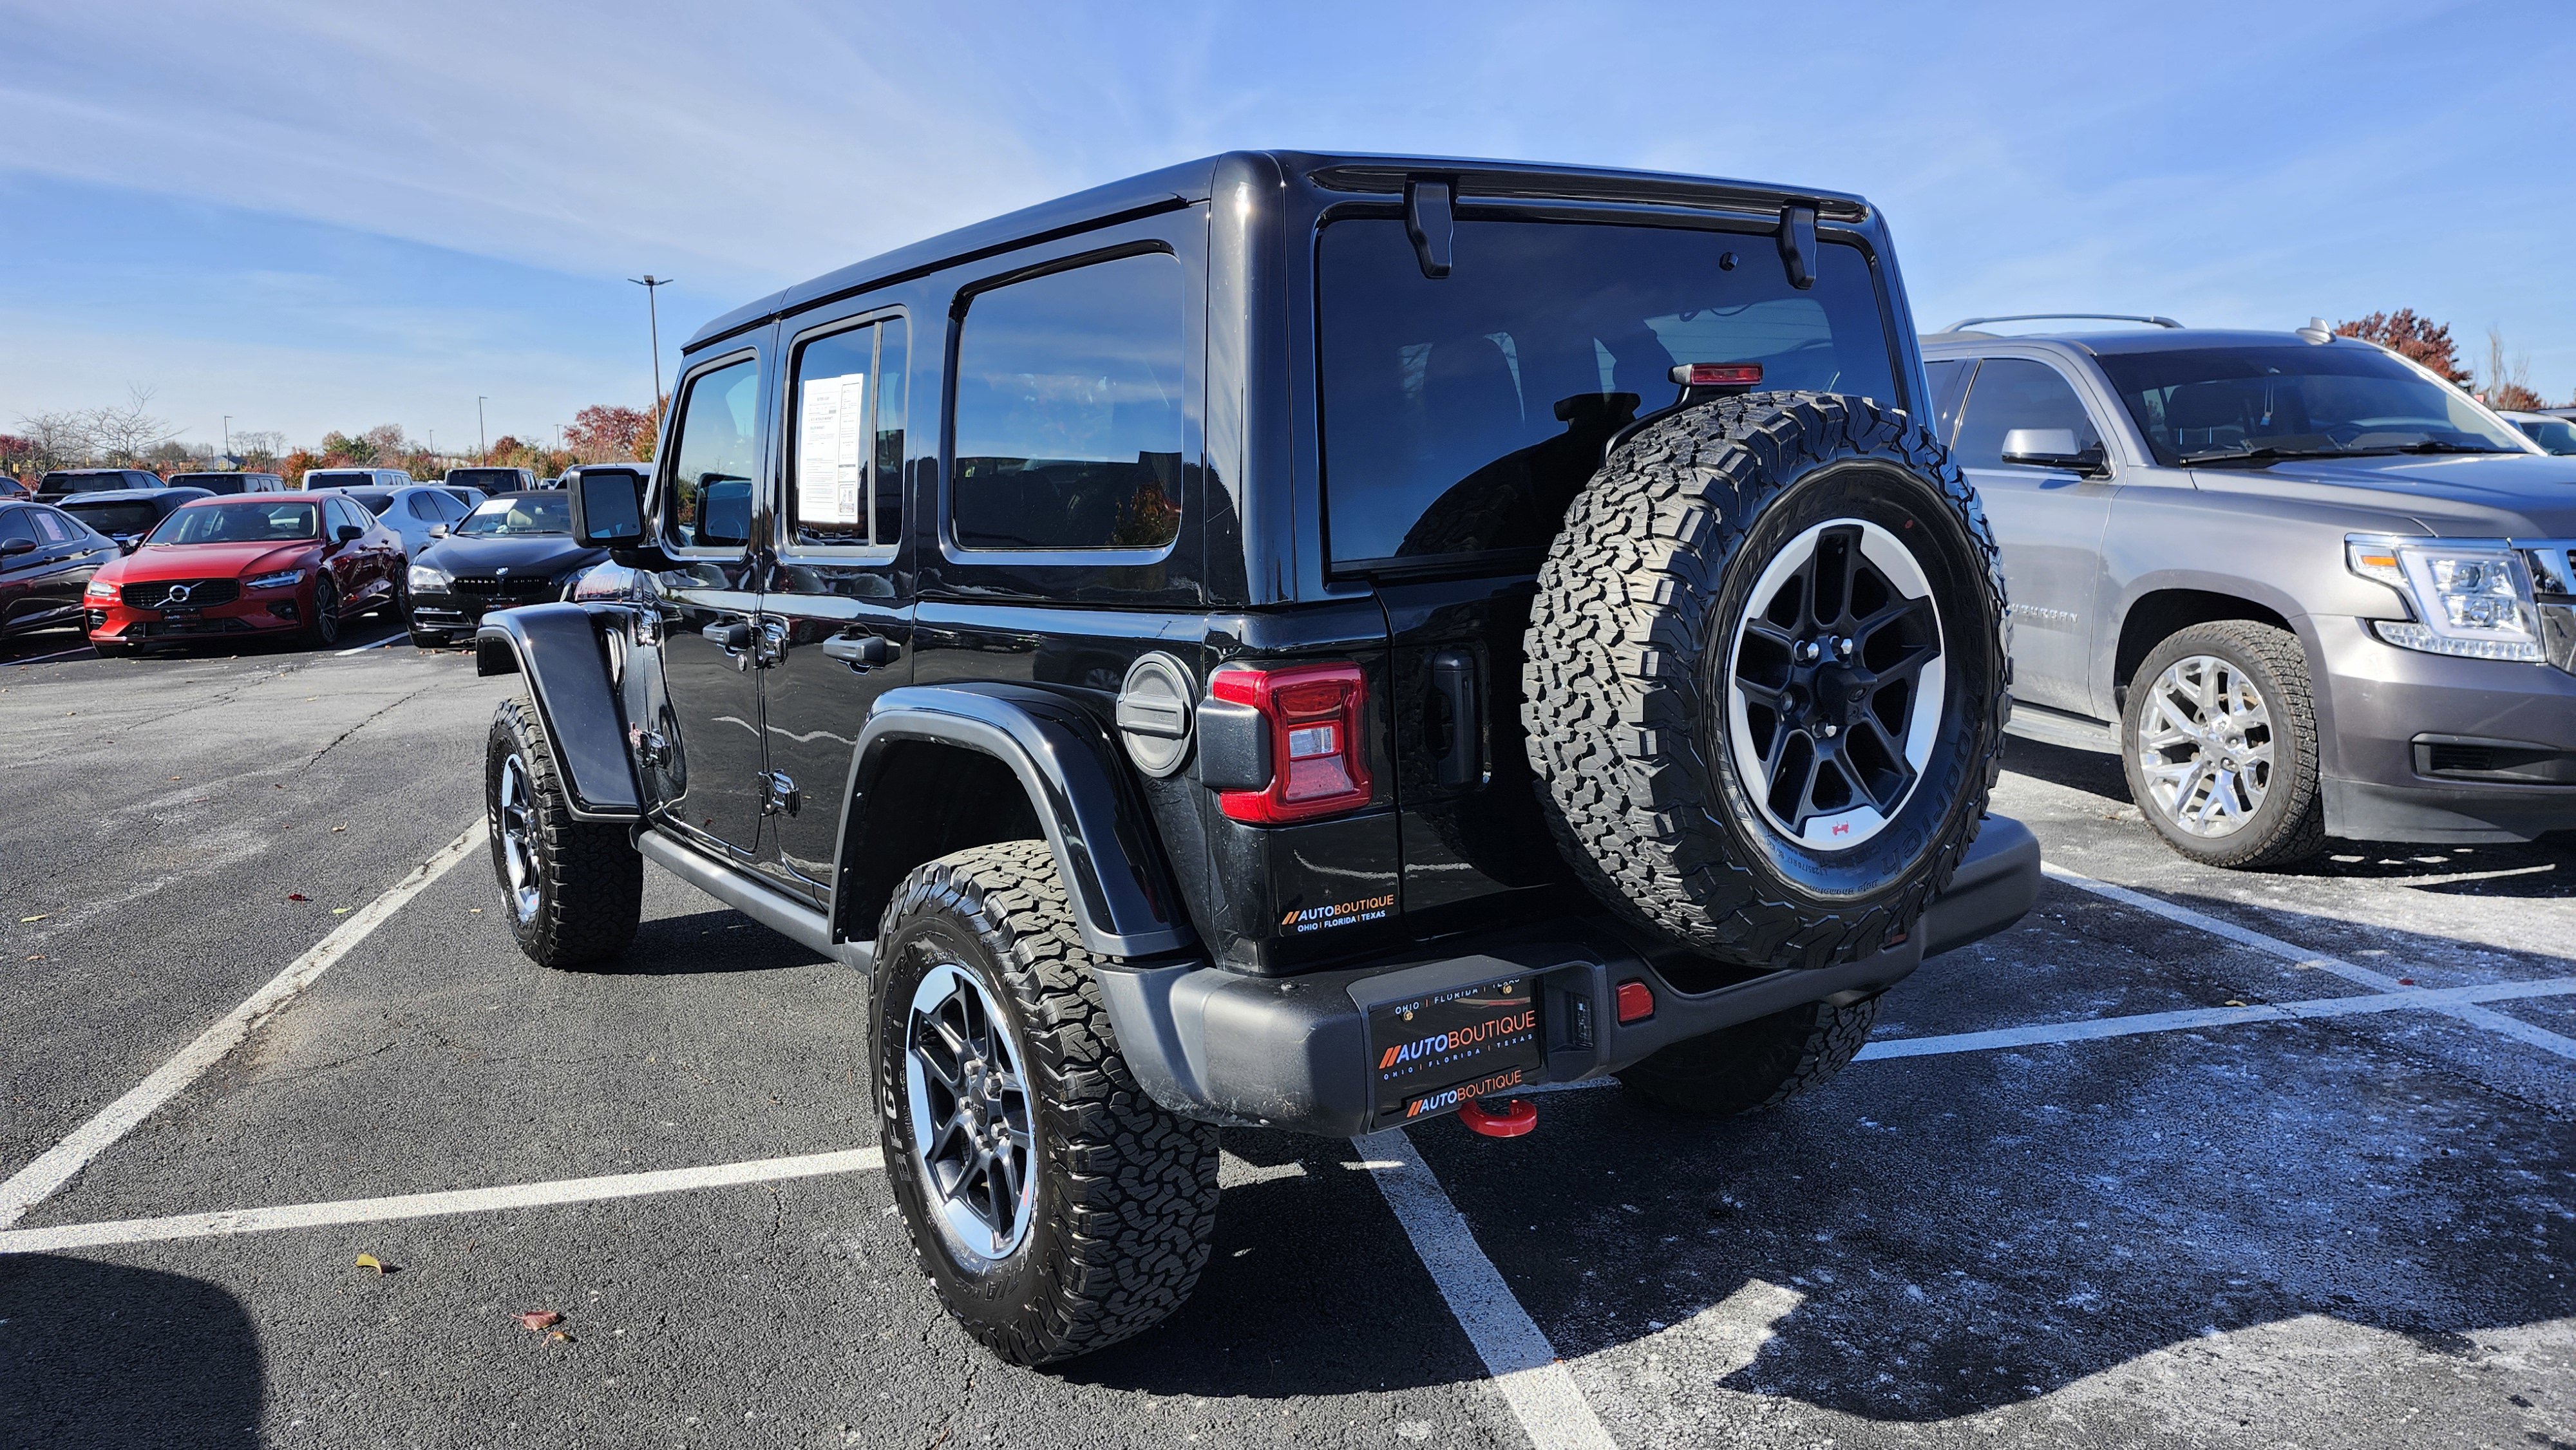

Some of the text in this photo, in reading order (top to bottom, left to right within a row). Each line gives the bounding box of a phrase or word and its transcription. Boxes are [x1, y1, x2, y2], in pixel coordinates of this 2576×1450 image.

[1297, 910, 1387, 933] OHIO FLORIDA TEXAS
[1298, 894, 1394, 922] AUTOBOUTIQUE
[1395, 1001, 1420, 1015] OHIO
[1396, 1010, 1536, 1064] AUTOBOUTIQUE
[1383, 1033, 1533, 1081] OHIO FLORIDA TEXAS
[1419, 1069, 1522, 1114] AUTOBOUTIQUE
